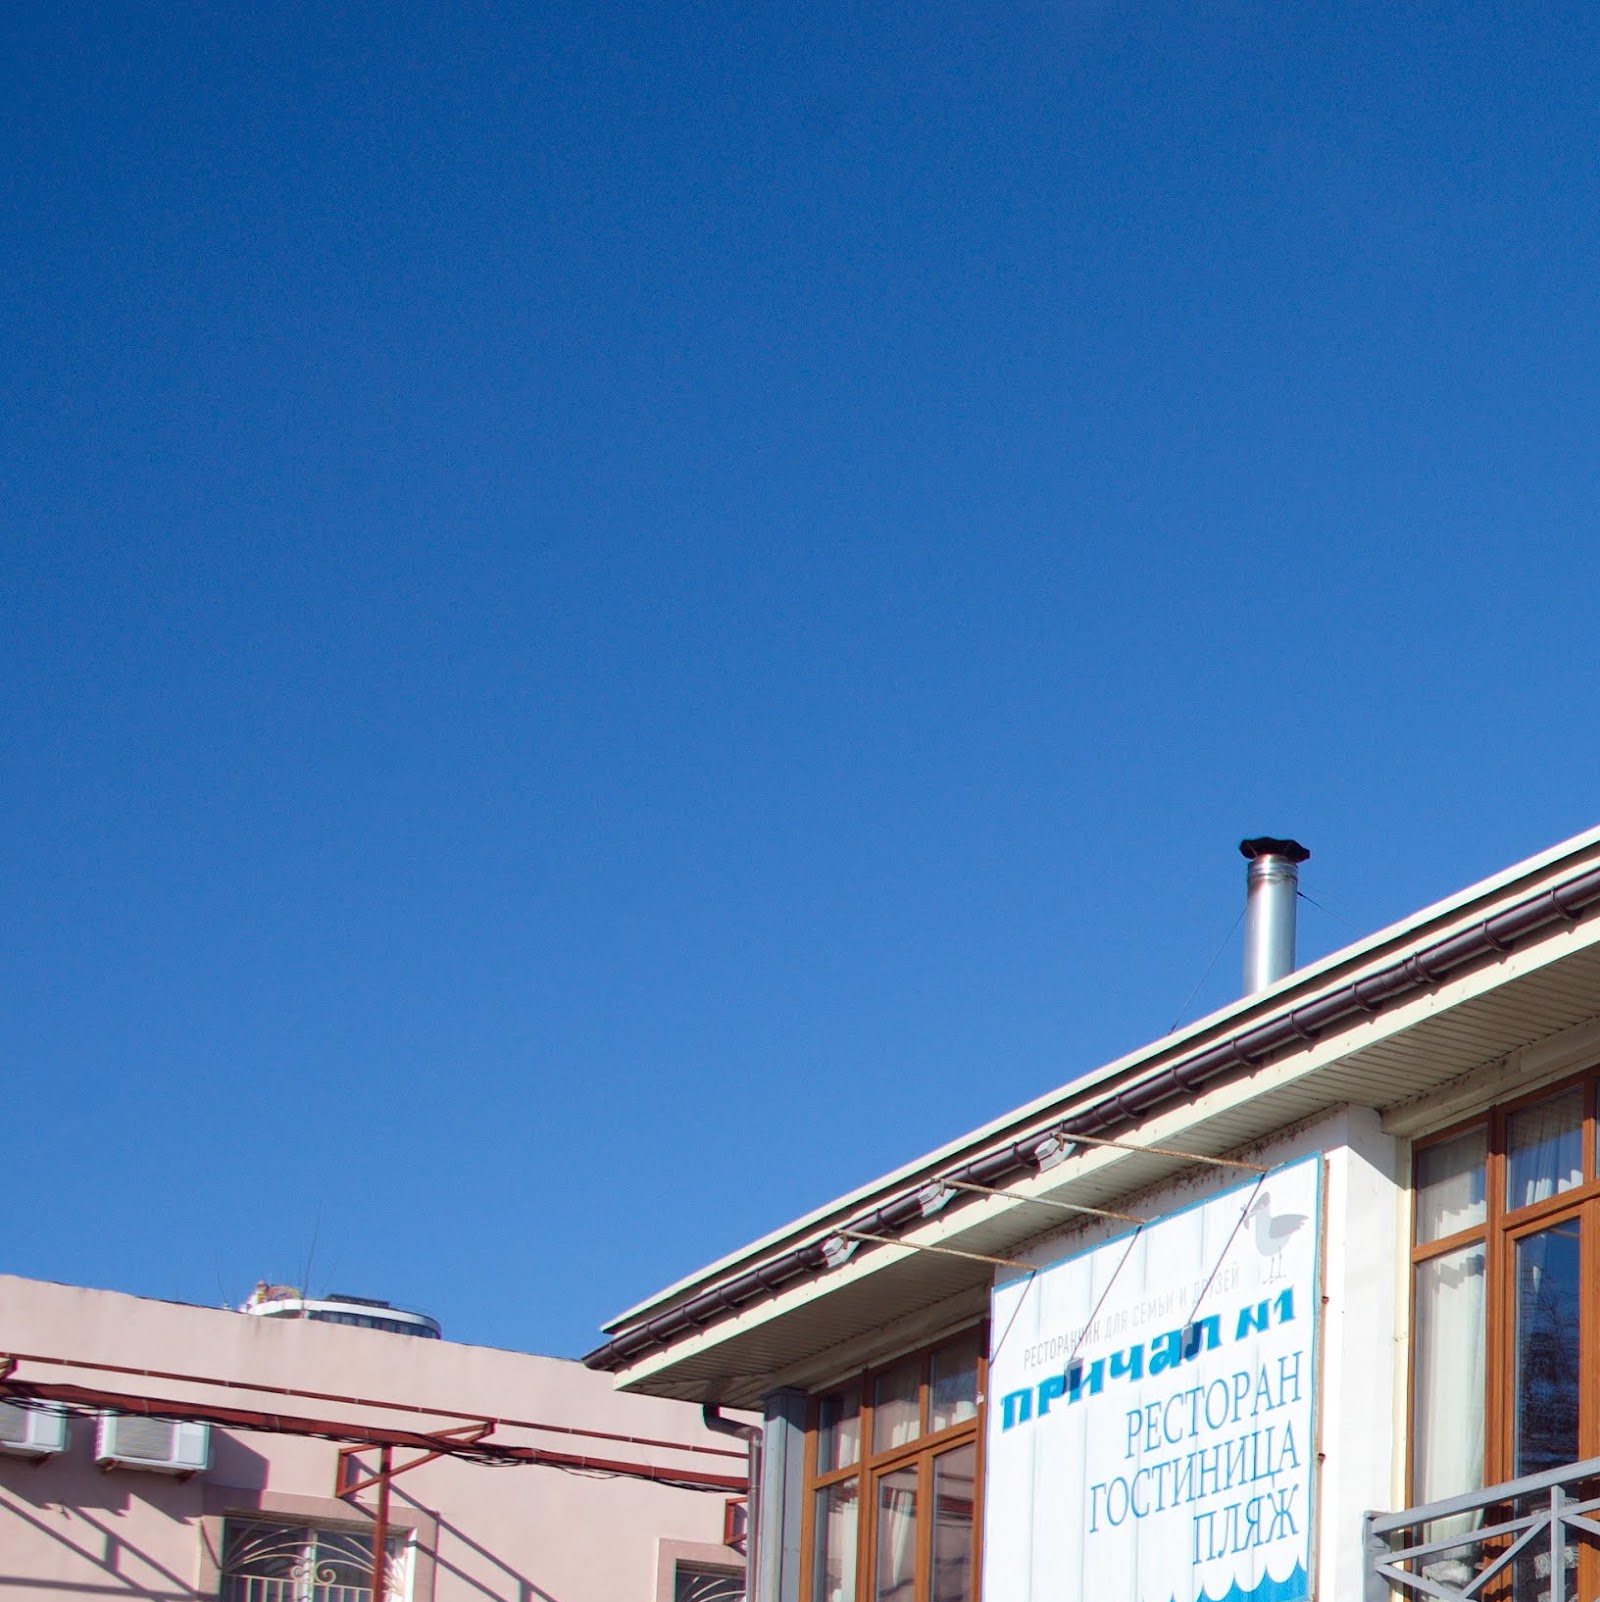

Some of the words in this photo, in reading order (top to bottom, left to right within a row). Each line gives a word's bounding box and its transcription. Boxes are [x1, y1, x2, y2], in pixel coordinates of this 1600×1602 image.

[1023, 1321, 1100, 1371] РЕСТОРАНЧИК
[1104, 1310, 1128, 1338] ДЛЯ
[1132, 1294, 1175, 1328] СЕМЬИ
[1179, 1289, 1187, 1308] И
[1124, 1350, 1303, 1460] РЕСТОРАН
[1089, 1419, 1301, 1534] ГОСТИНИЦА
[1192, 1484, 1299, 1566] ПЛЯЖ
